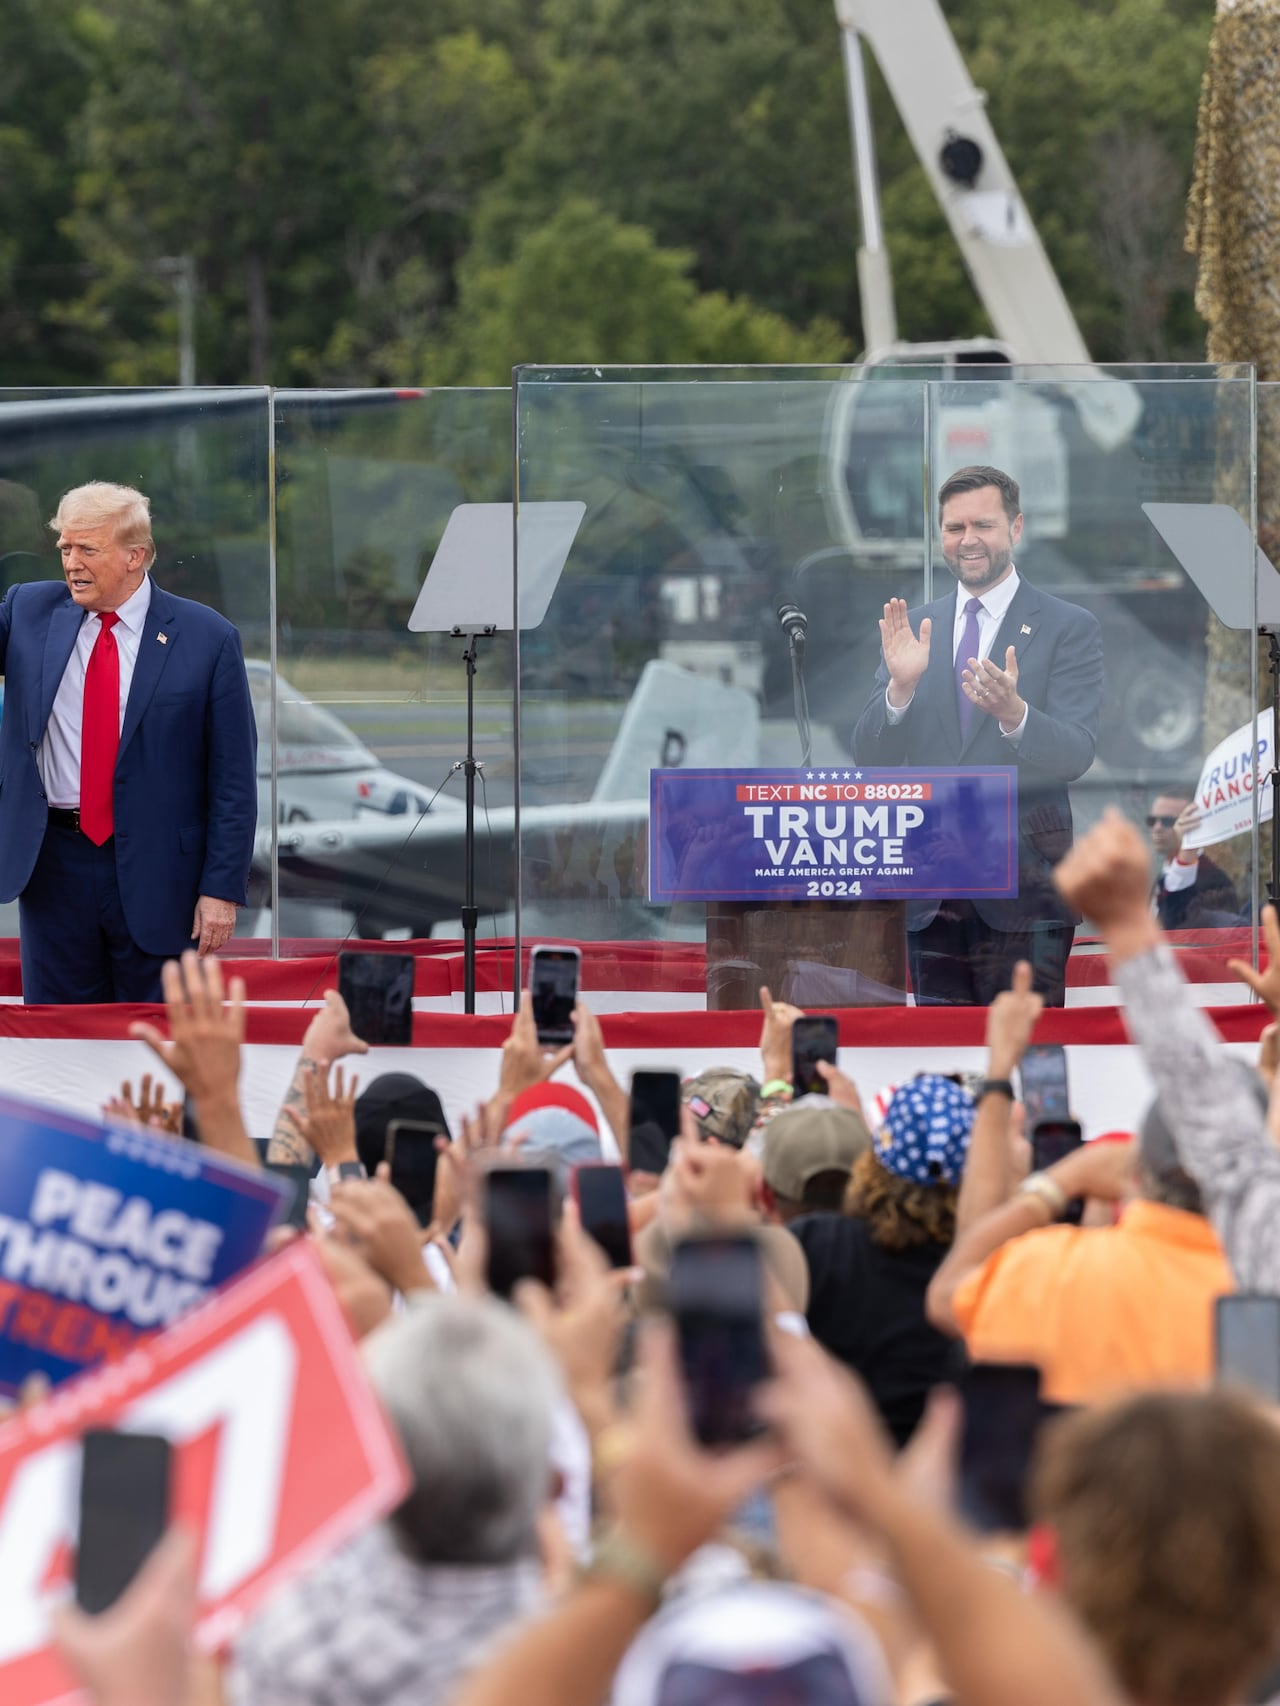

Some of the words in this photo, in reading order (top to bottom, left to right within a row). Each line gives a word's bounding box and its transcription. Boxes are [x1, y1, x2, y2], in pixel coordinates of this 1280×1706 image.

[745, 785, 794, 801] TEXT
[800, 785, 827, 801] NC
[833, 784, 859, 800] TO
[864, 784, 924, 800] 88022
[743, 805, 925, 839] TRUMP
[764, 839, 904, 866] VANCE
[755, 868, 785, 877] MAKE
[788, 868, 836, 877] AMERICA
[839, 867, 874, 876] GREAT
[876, 866, 914, 876] AGAIN!
[806, 880, 863, 897] 2024
[30, 1168, 223, 1281] PEACE
